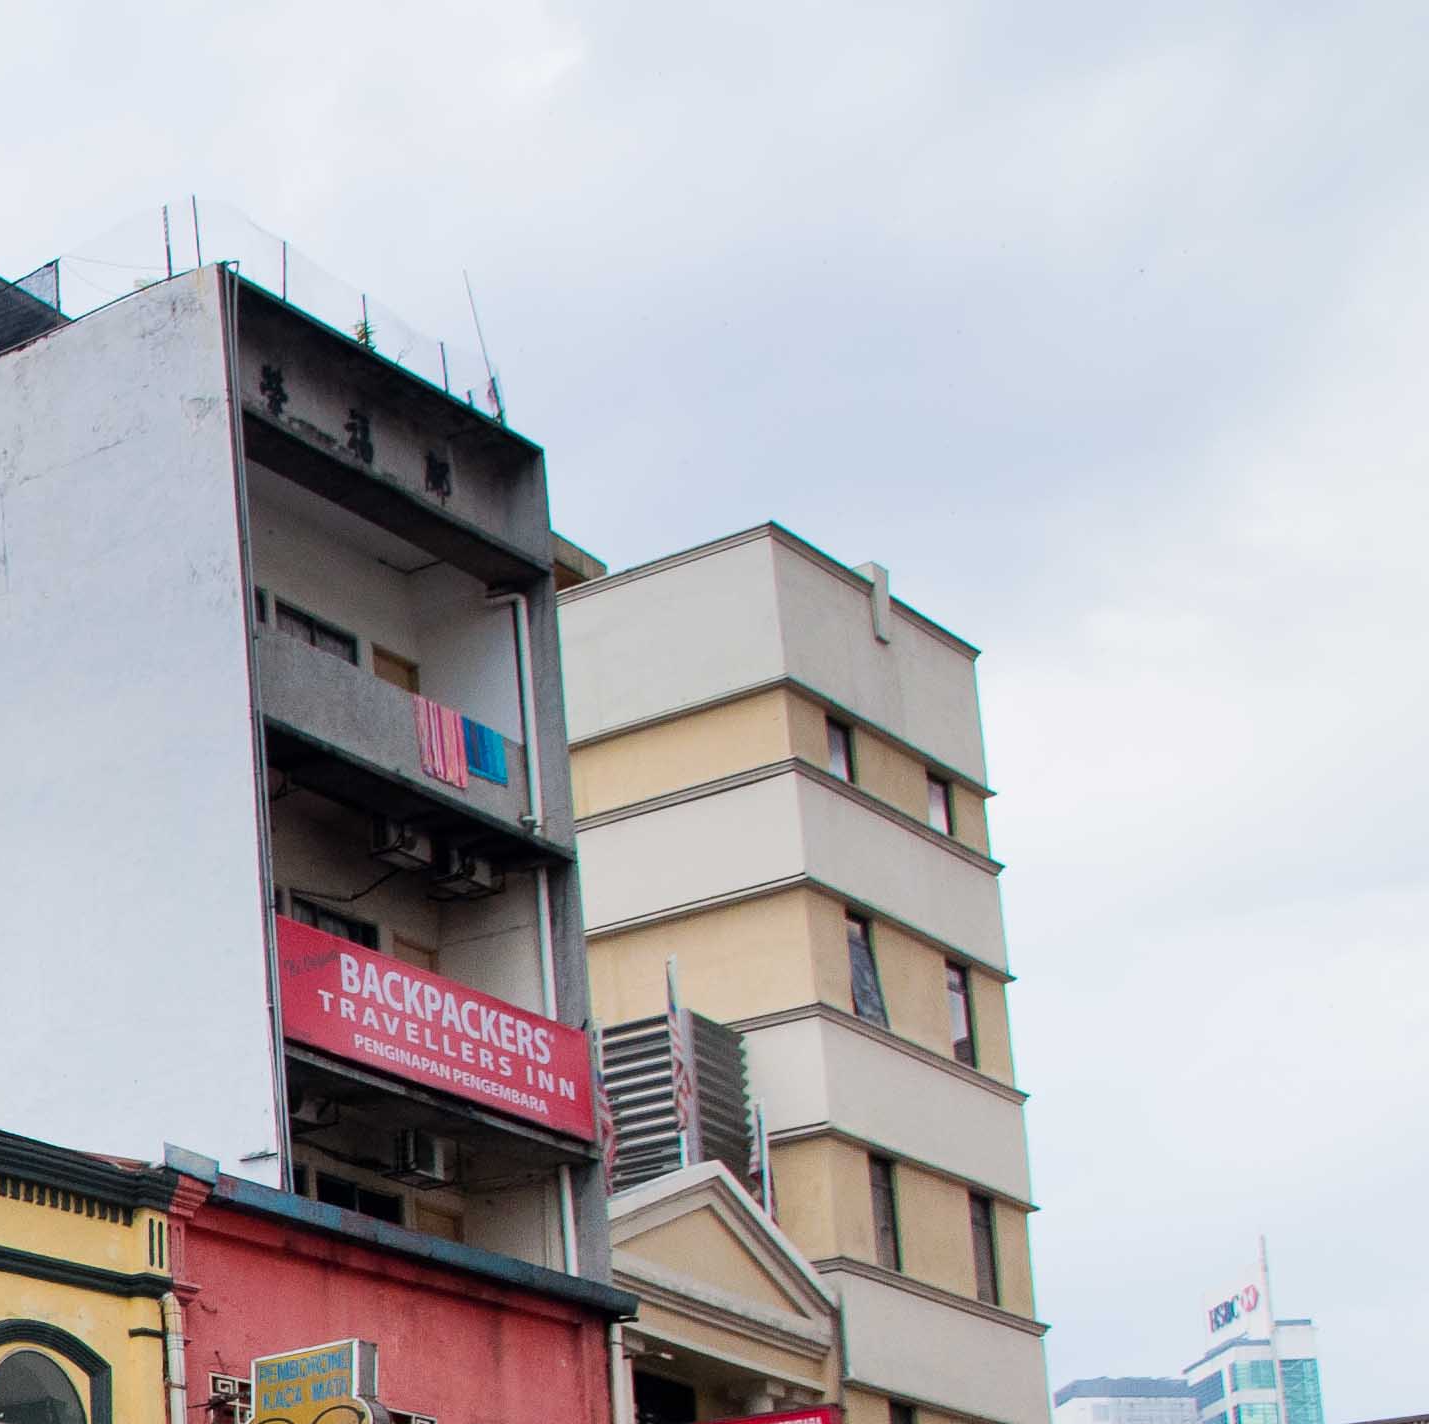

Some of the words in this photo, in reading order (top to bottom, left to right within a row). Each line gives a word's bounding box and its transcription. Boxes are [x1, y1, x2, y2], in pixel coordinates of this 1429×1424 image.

[317, 988, 513, 1079] TRAVELLERS
[525, 1064, 576, 1101] INN
[340, 952, 552, 1065] BACKPACKERS
[353, 1032, 450, 1081] PENGINAPAN
[452, 1067, 549, 1115] PENGEMBARA
